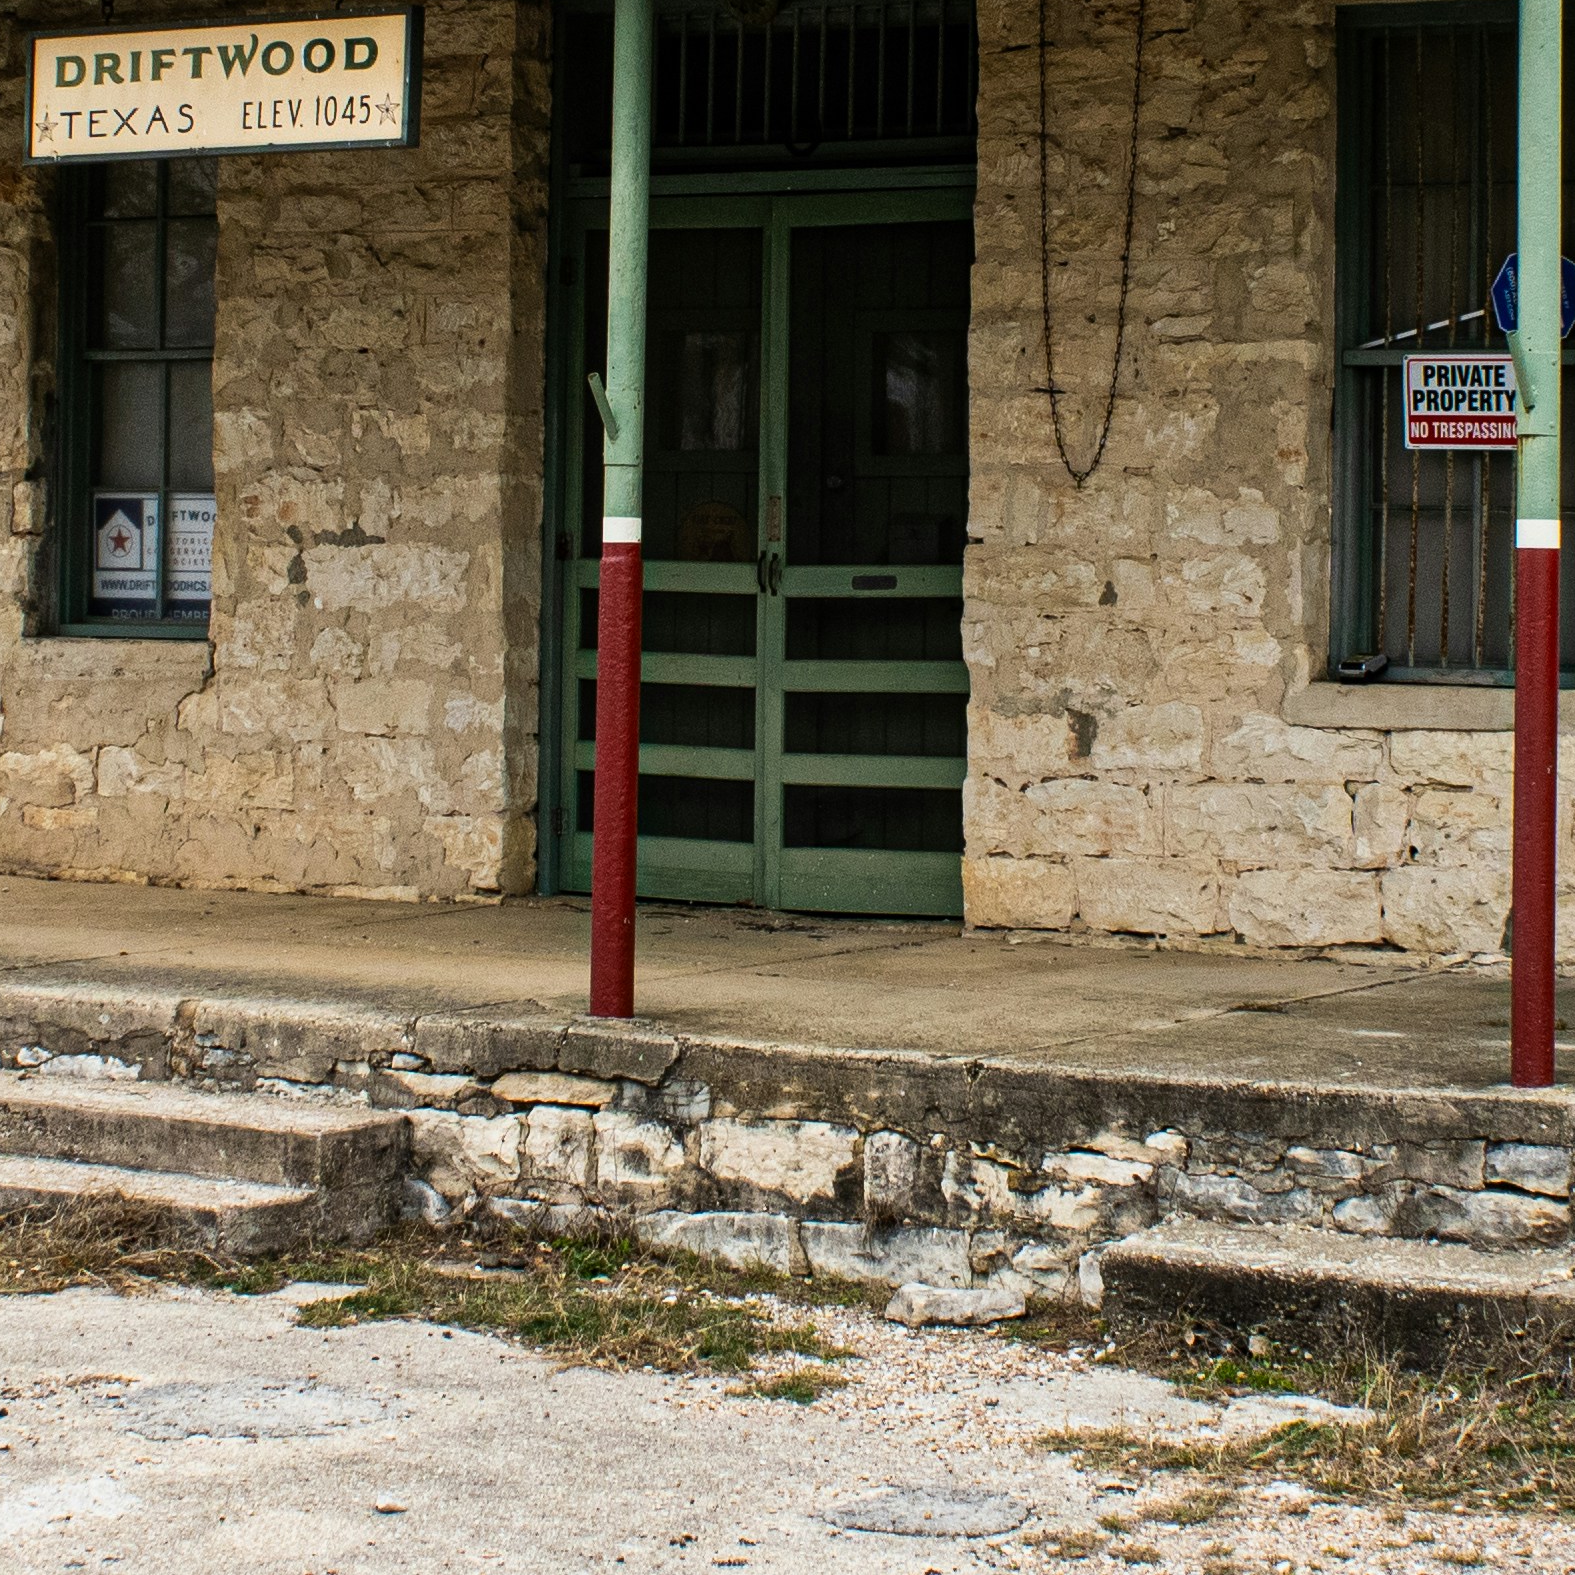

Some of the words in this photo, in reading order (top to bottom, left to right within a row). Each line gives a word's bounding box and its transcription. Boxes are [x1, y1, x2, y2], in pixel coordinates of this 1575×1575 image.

[55, 33, 379, 88] DRIFTWOOD
[60, 103, 195, 139] TEXAS
[242, 99, 303, 130] ELEV.
[315, 94, 372, 126] 1045
[1422, 364, 1506, 387] PRIVATE
[1412, 389, 1517, 412] PROPERTY
[1410, 421, 1429, 438] NO
